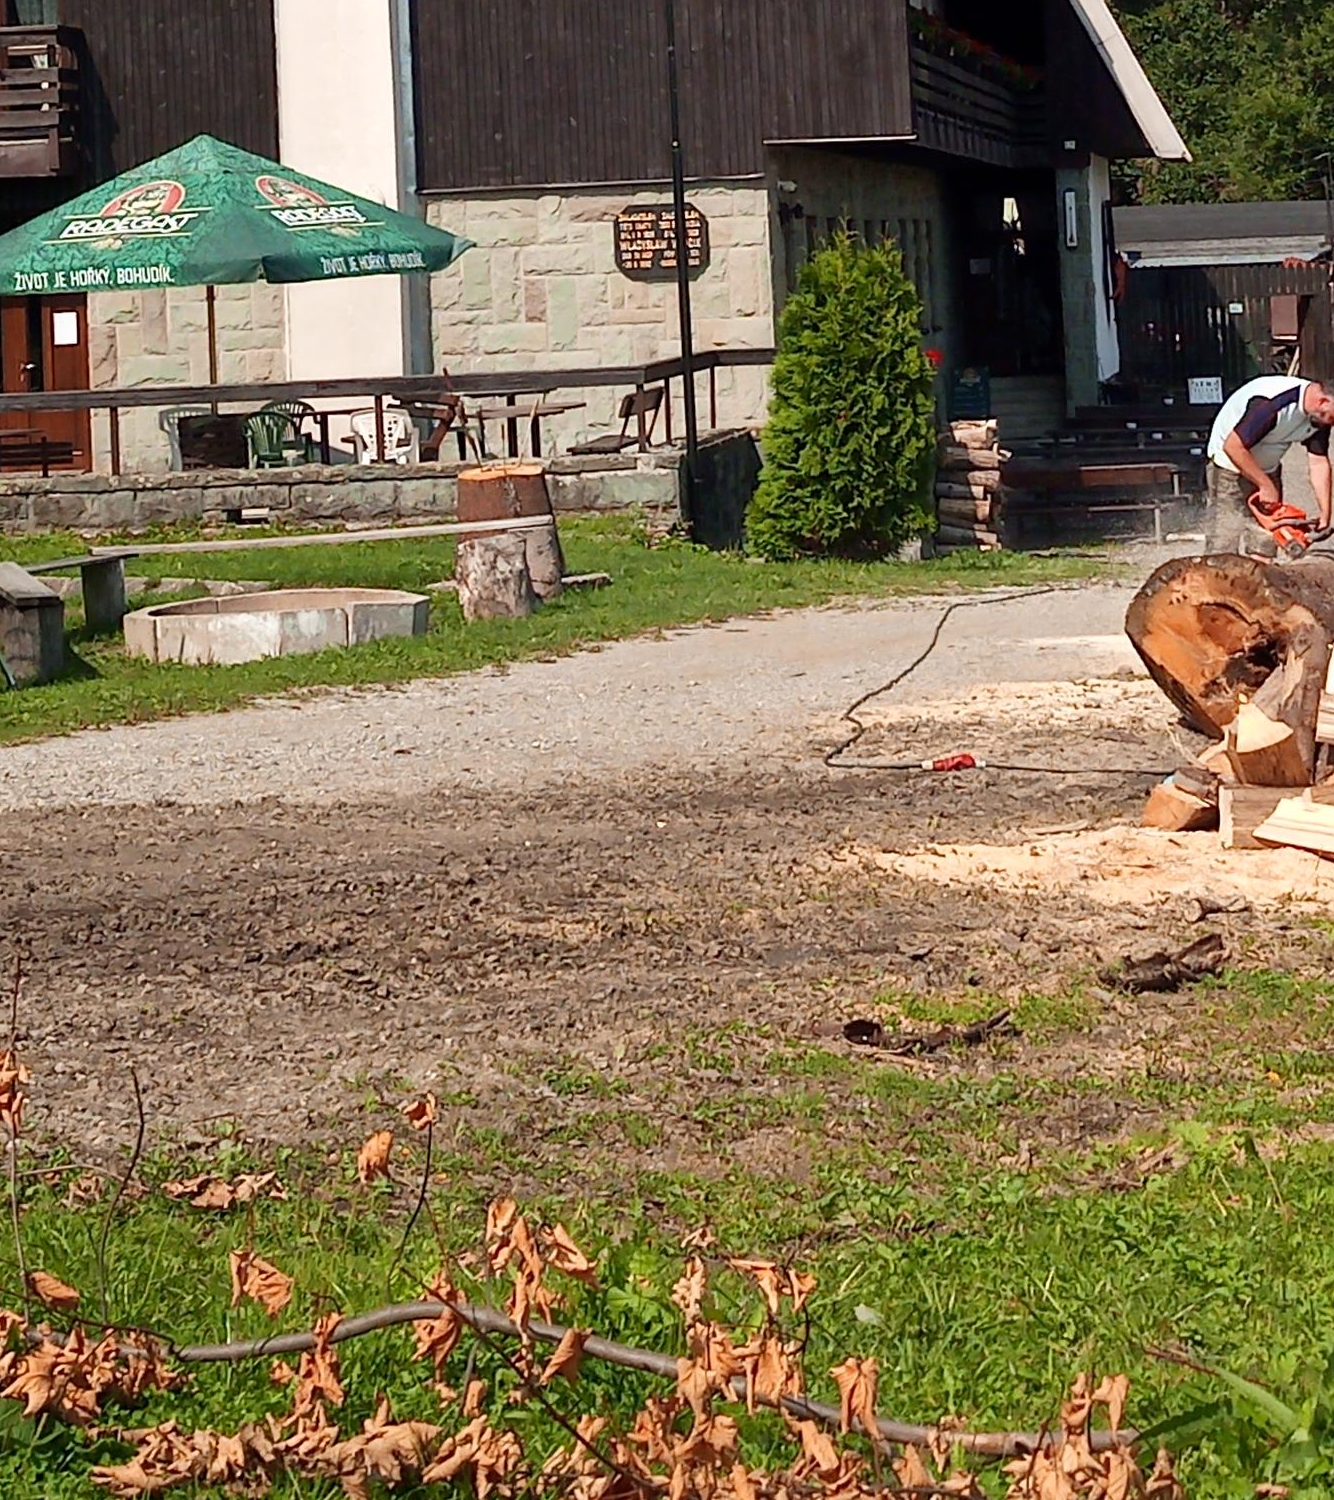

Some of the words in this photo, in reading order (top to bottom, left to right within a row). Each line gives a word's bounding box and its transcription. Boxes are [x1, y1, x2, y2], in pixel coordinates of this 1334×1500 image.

[59, 212, 200, 239] RADEGAST
[270, 205, 367, 227] RADEGAST
[14, 271, 49, 291] ŽIVOT
[53, 271, 68, 288] JE
